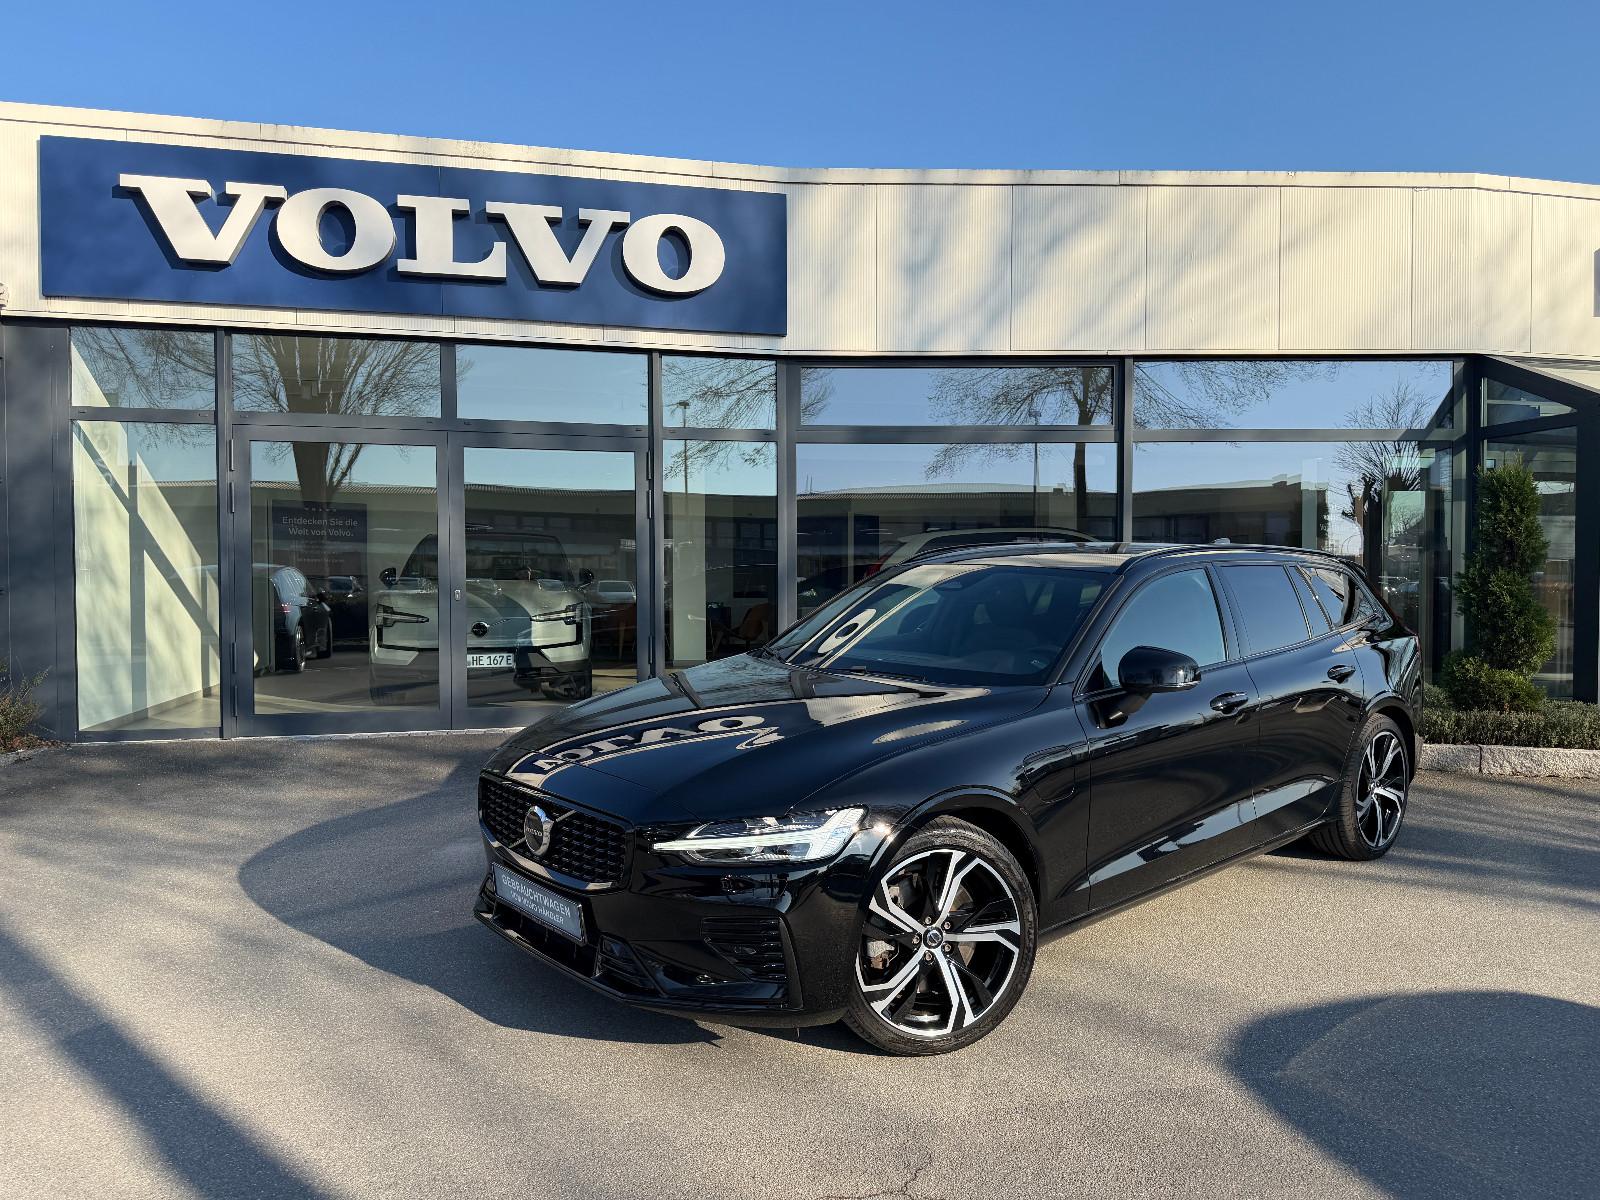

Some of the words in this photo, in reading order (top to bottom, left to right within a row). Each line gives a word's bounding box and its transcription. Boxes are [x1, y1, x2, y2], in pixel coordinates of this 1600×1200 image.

[119, 173, 726, 294] VOLVO
[282, 516, 328, 526] Entdecken
[329, 518, 343, 526] Sie
[345, 518, 358, 527] die
[472, 655, 485, 666] HE
[501, 874, 571, 918] GEBRAUCHTWAGEN
